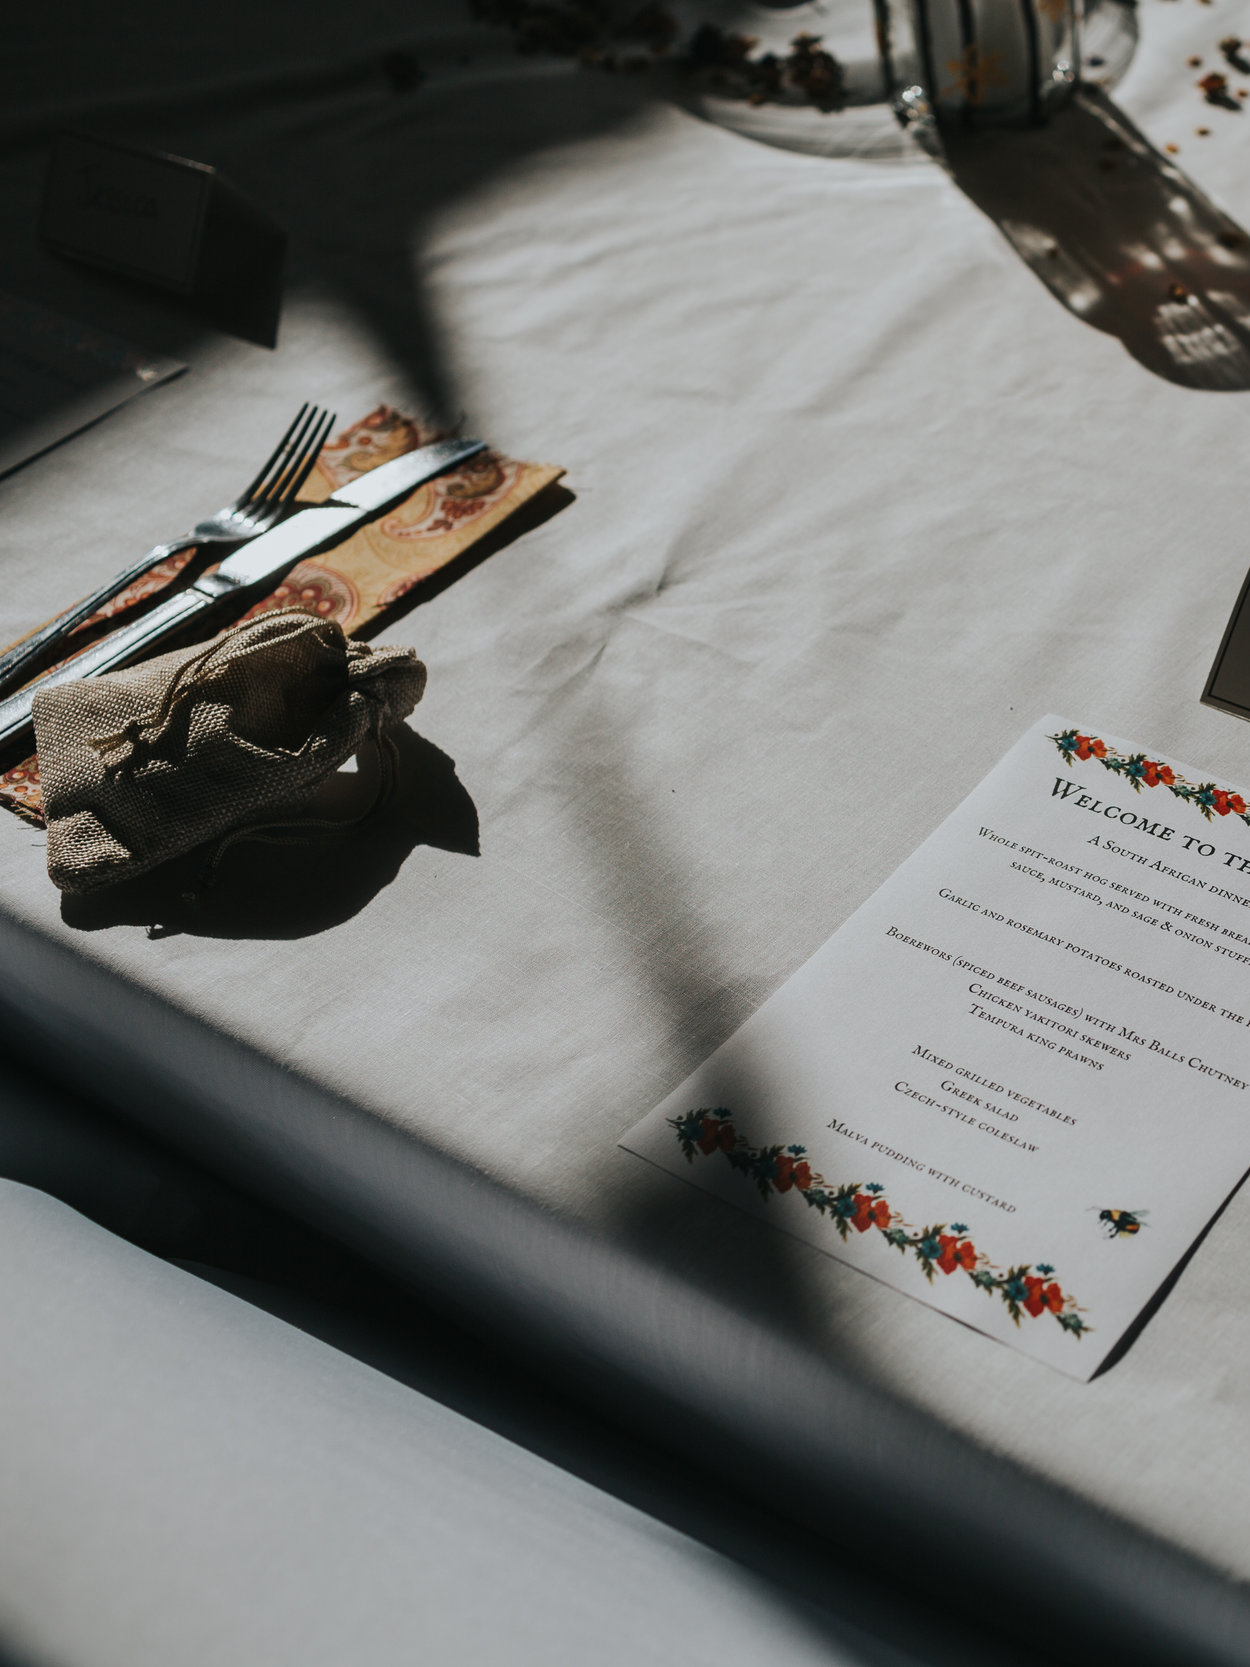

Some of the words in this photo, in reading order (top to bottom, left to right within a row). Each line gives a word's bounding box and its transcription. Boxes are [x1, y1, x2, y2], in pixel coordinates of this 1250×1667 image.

[1051, 777, 1176, 842] WELCOME
[1181, 835, 1216, 857] TO
[978, 826, 1019, 850] WHOLE
[1018, 845, 1084, 875] SPIT-ROAST
[1082, 871, 1109, 886] HOG
[1108, 882, 1150, 903] SERVED
[1152, 899, 1184, 917] WITH
[1183, 912, 1221, 932] FRESH
[1086, 835, 1101, 847] A
[1102, 839, 1149, 865] SOUTH
[1148, 860, 1208, 889] AFRICAN
[1009, 861, 1046, 883] SAUCE,
[1048, 877, 1103, 906] MUSTARD,
[1105, 901, 1130, 914] AND
[1130, 910, 1159, 927] SAGE
[1159, 920, 1174, 933] &
[1174, 928, 1214, 949] ONION
[938, 888, 981, 912] GARLIC
[980, 909, 1005, 922] AND
[1005, 918, 1065, 947] ROSEMARY
[1064, 942, 1123, 972] POTATOES
[1123, 967, 1175, 994] ROASTED
[1176, 990, 1217, 1013] UNDER
[1220, 1008, 1245, 1024] THE
[885, 925, 953, 962] BOEREWORS
[952, 955, 996, 980] (SPICED
[996, 977, 1026, 993] BEEF
[1024, 989, 1084, 1020] SAUSAGES)
[1084, 1014, 1117, 1033] WITH
[1117, 1026, 1147, 1046] MRS
[1147, 1039, 1186, 1064] BALLS
[1187, 1057, 1250, 1091] CHUTNEY
[968, 982, 1024, 1014] CHICKEN
[1024, 1009, 1080, 1039] YAKITORI
[1079, 1034, 1132, 1062] SKEWERS
[968, 1002, 1024, 1037] TEMPURA
[1025, 1032, 1058, 1050] KING
[1057, 1045, 1105, 1071] PRAWNS
[894, 1081, 977, 1126] CZECH-STYLE
[977, 1122, 1040, 1153] COLESLAW
[911, 1044, 954, 1070] MIXED
[954, 1067, 1005, 1093] GRILLED
[1007, 1089, 1078, 1126] VEGETABLES
[940, 1080, 983, 1107] GREEK
[983, 1102, 1019, 1122] SALAD
[825, 1118, 869, 1146] MALVA
[870, 1141, 927, 1172] PUDDING
[927, 1167, 961, 1188] WITH
[961, 1184, 1017, 1214] CUSTARD
